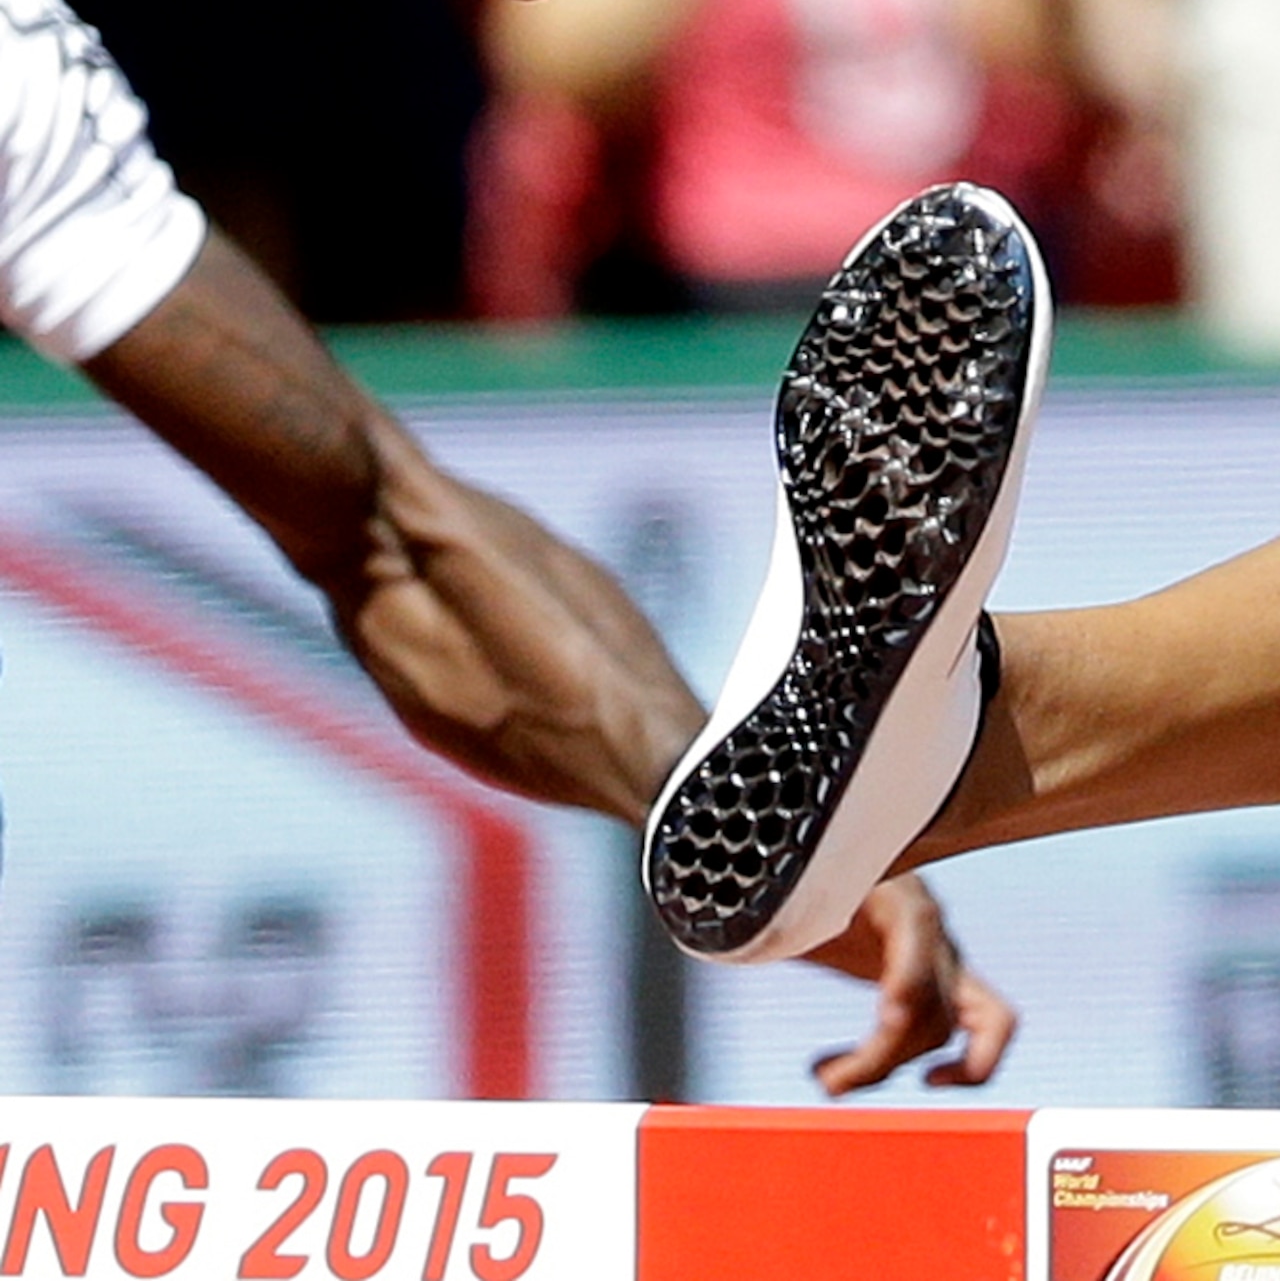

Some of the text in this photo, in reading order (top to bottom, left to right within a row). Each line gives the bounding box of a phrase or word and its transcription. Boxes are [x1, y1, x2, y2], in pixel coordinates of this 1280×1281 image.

[1053, 1174, 1100, 1191] World
[1053, 1190, 1169, 1212] Championships
[236, 1148, 560, 1281] 2015
